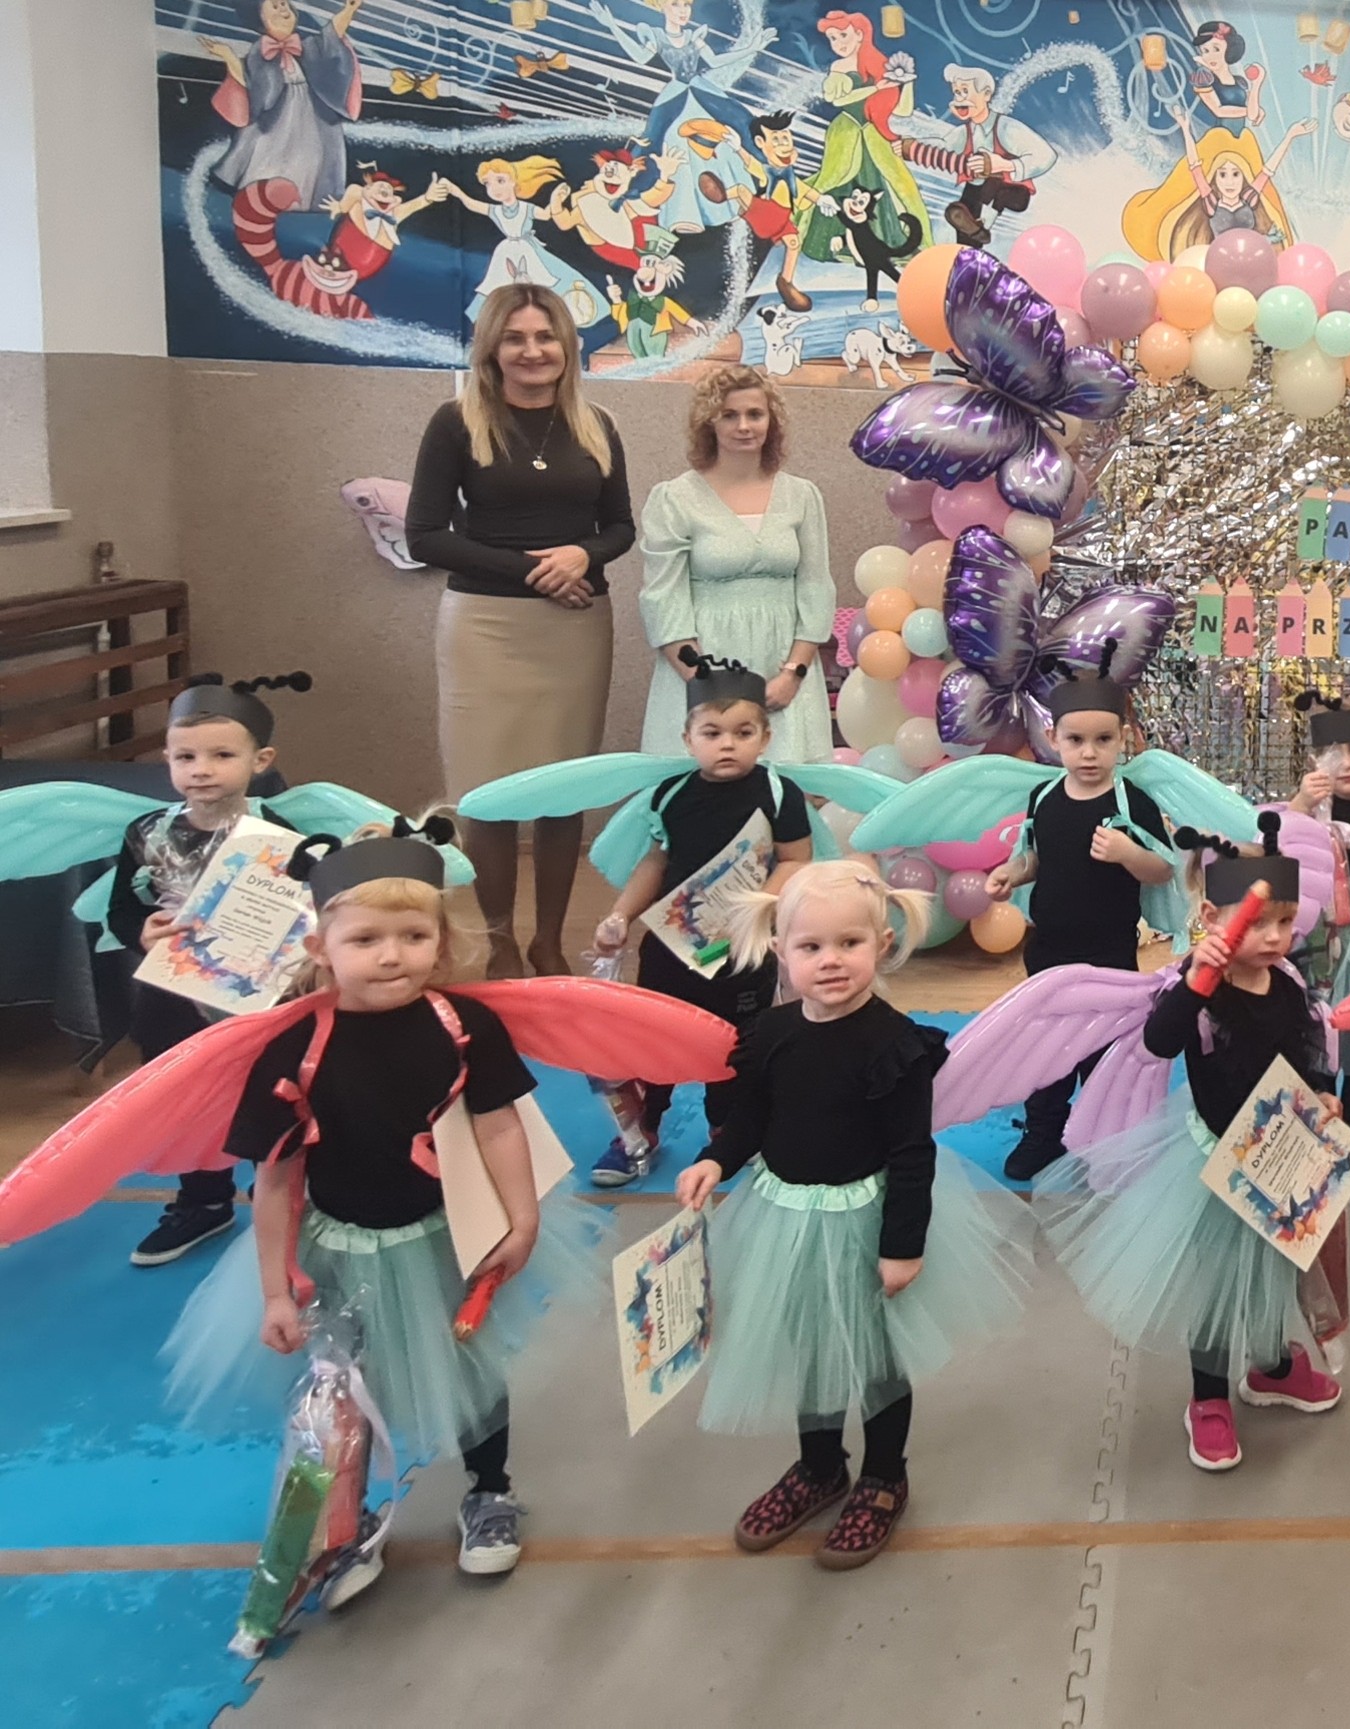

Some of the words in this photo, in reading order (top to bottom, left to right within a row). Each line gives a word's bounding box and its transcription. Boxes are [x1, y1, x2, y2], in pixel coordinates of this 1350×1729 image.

[1199, 613, 1250, 635] NA
[246, 874, 297, 900] DYPLOM
[1251, 1120, 1285, 1170] DYPLOM
[654, 1283, 667, 1352] DYPLOM
